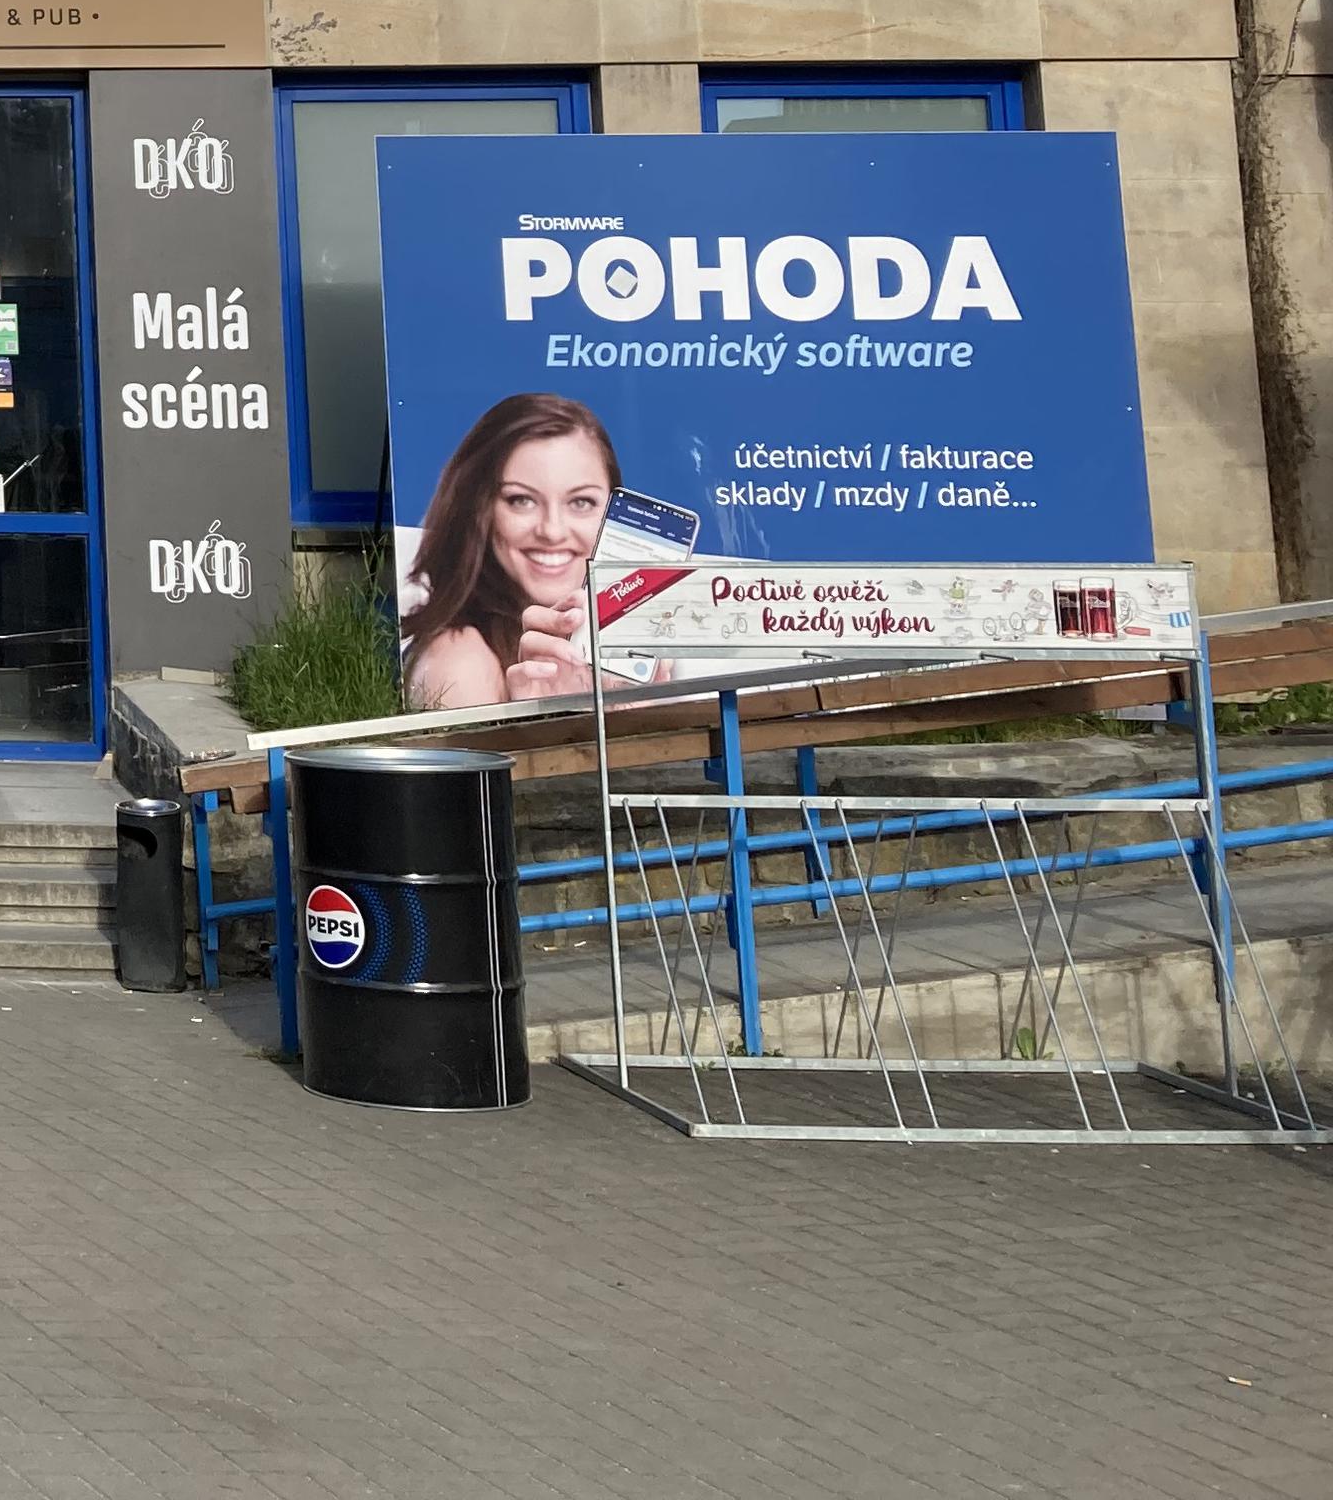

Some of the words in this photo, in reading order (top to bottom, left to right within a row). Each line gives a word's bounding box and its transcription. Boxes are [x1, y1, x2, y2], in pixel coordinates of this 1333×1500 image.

[7, 8, 22, 26] &
[33, 8, 82, 26] PUB
[501, 235, 1023, 322] POHODA
[133, 286, 250, 350] Malá
[546, 332, 788, 375] Ekonomický
[795, 333, 974, 368] software
[121, 365, 269, 430] scéna
[735, 442, 872, 469] účetnictví
[899, 444, 1034, 470] fakturace
[715, 480, 807, 512] sklady
[834, 481, 910, 512] mzdy
[937, 481, 1037, 508] daně...
[711, 576, 807, 607] Poctivě
[812, 579, 889, 603] osvěží
[762, 606, 844, 638] každý
[851, 607, 936, 638] výkon
[306, 913, 360, 939] PEPSI
